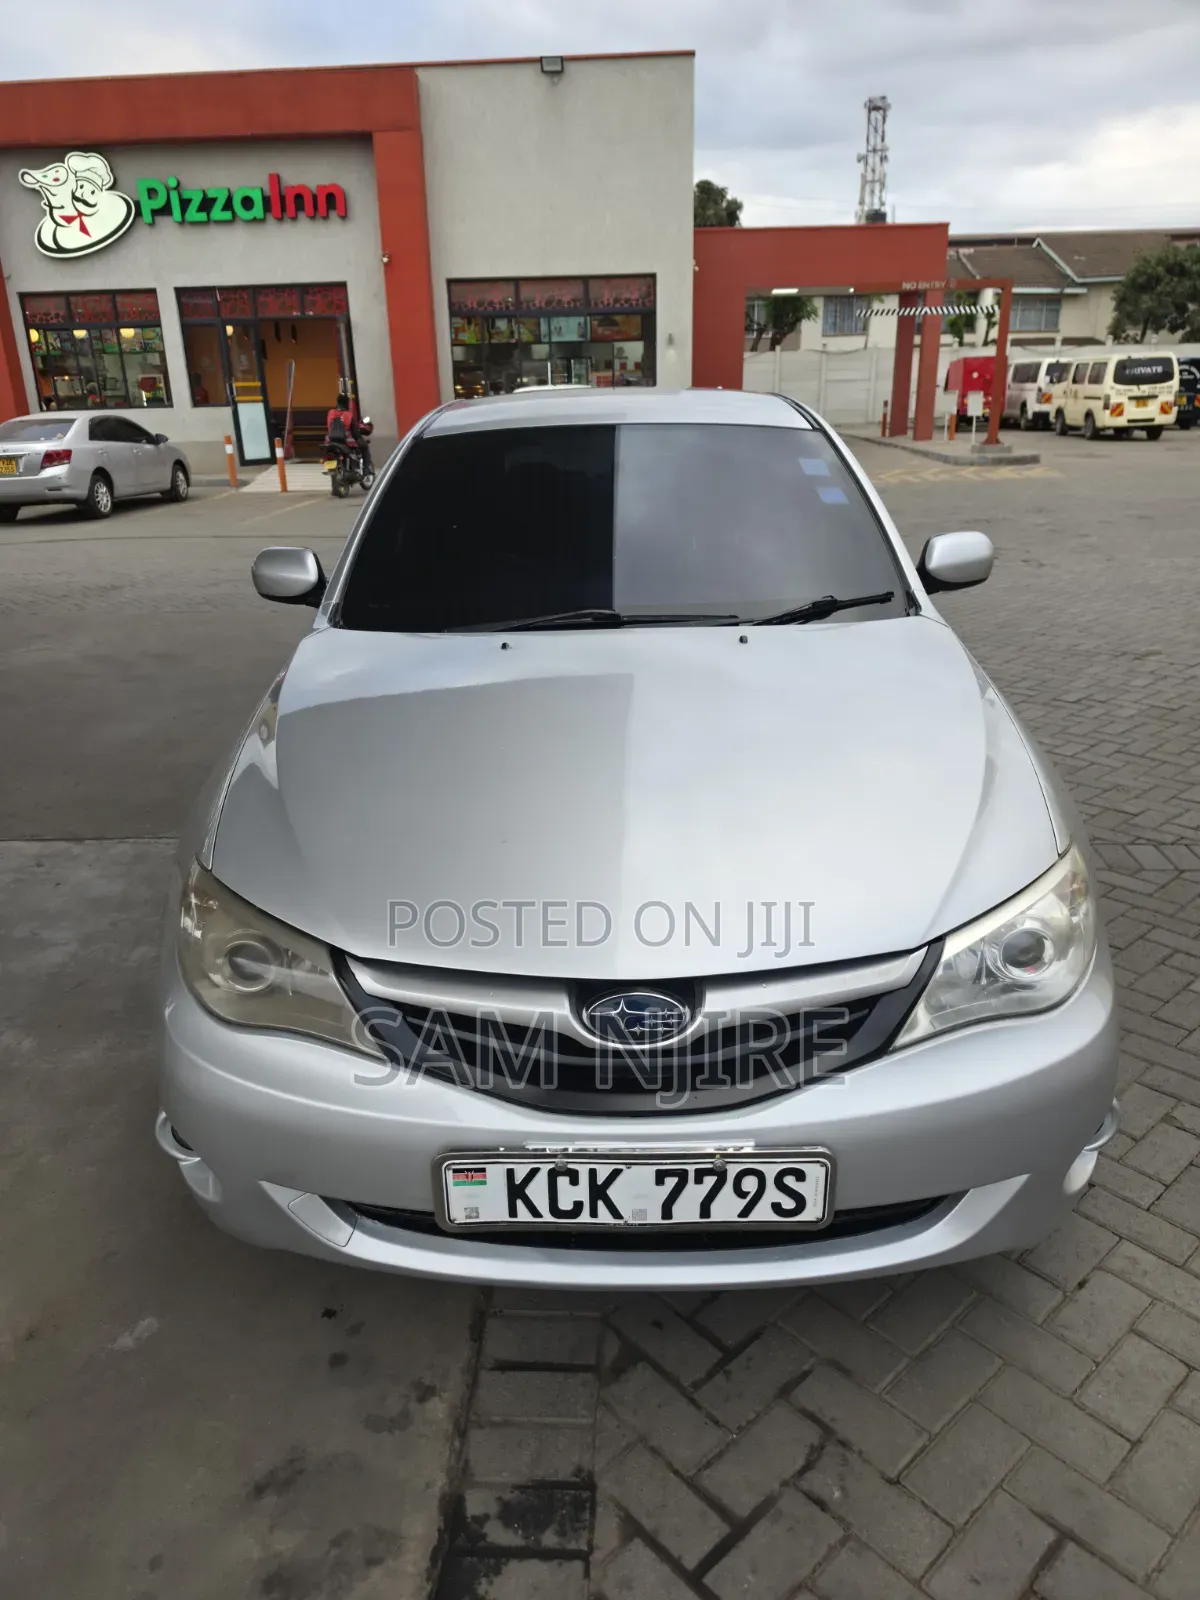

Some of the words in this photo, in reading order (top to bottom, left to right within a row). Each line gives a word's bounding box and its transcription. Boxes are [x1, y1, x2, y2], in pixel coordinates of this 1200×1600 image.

[902, 282, 917, 290] NO
[918, 281, 946, 289] ENTRY
[506, 1166, 625, 1220] KCK
[655, 1167, 807, 1221] 779S
